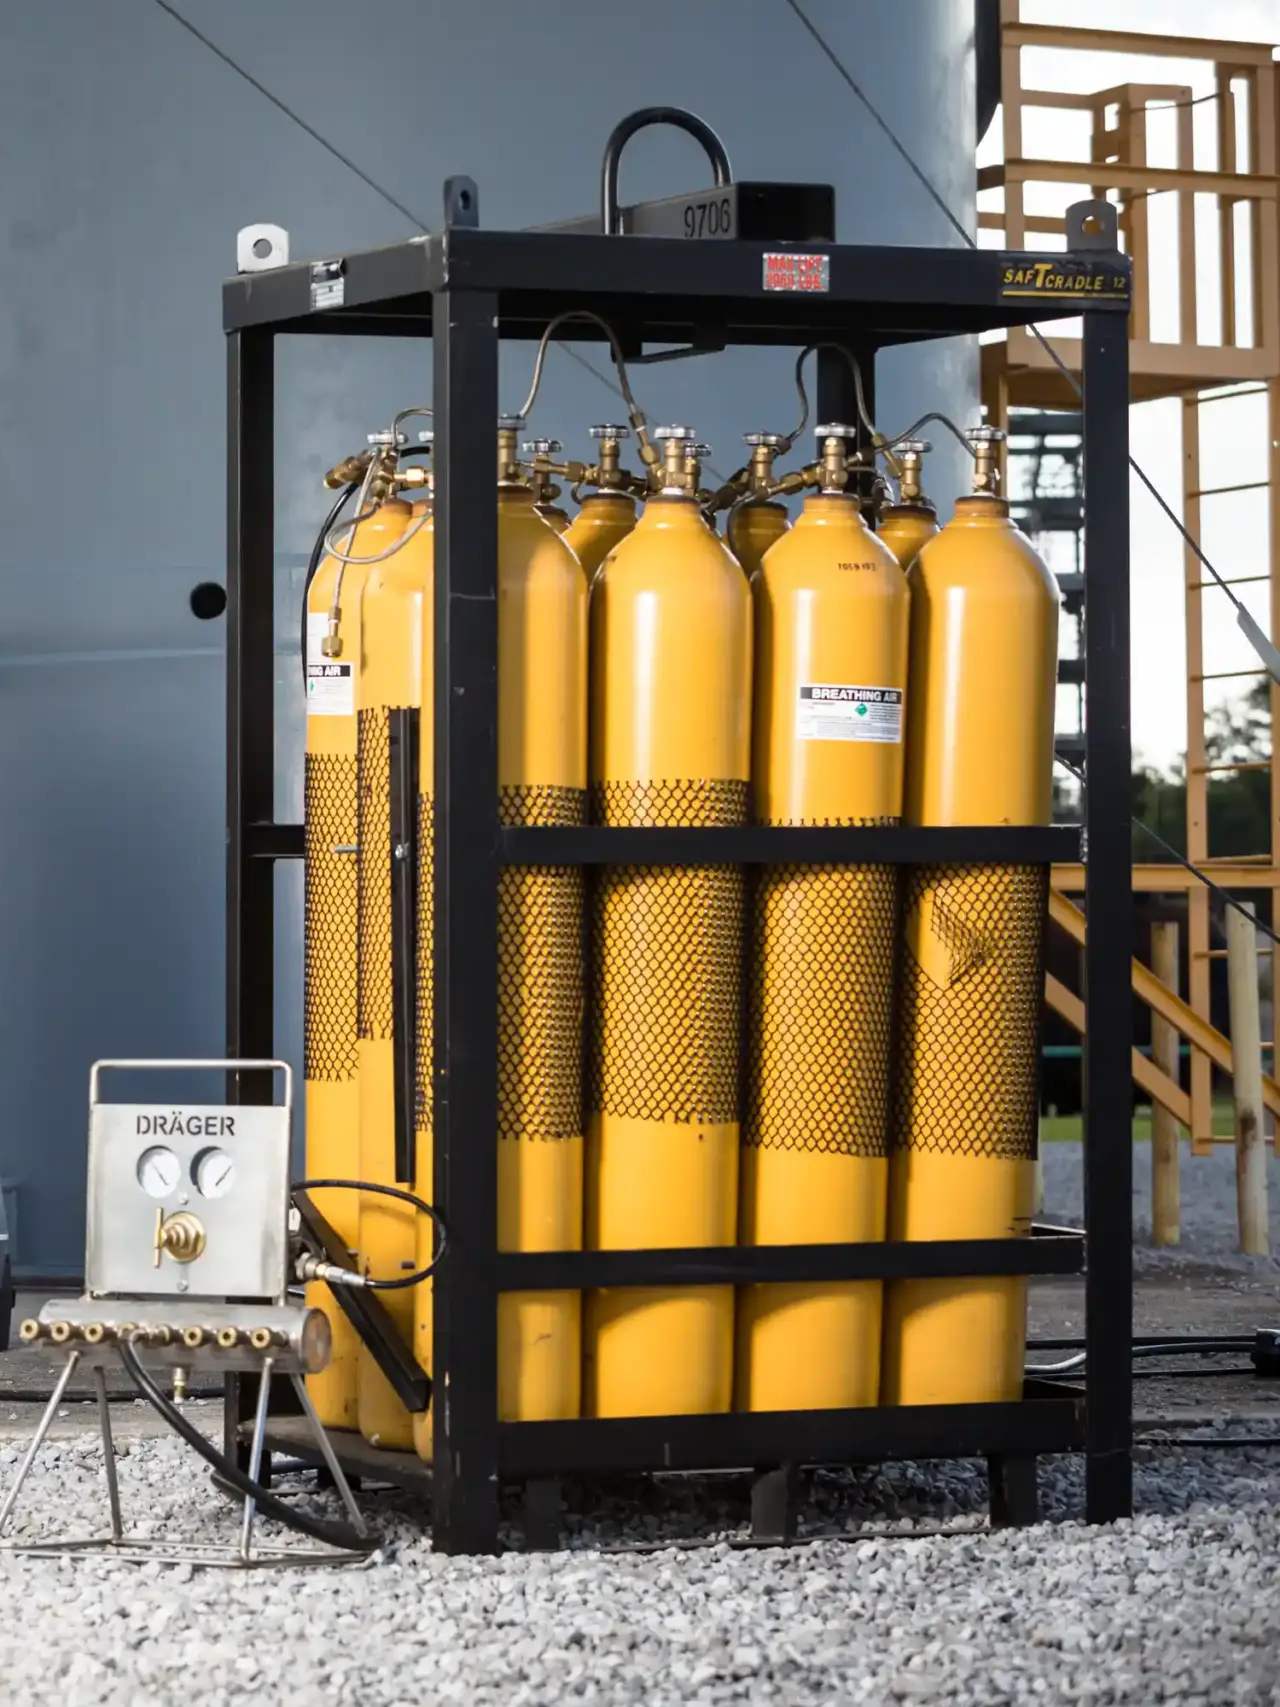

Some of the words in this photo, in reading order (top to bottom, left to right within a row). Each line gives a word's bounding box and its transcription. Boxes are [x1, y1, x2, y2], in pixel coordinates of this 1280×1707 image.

[684, 198, 731, 238] 9706
[324, 665, 341, 677] AIR
[811, 688, 881, 702] BREATHING
[883, 692, 898, 703] AIR
[136, 1110, 235, 1136] DRÄGER
